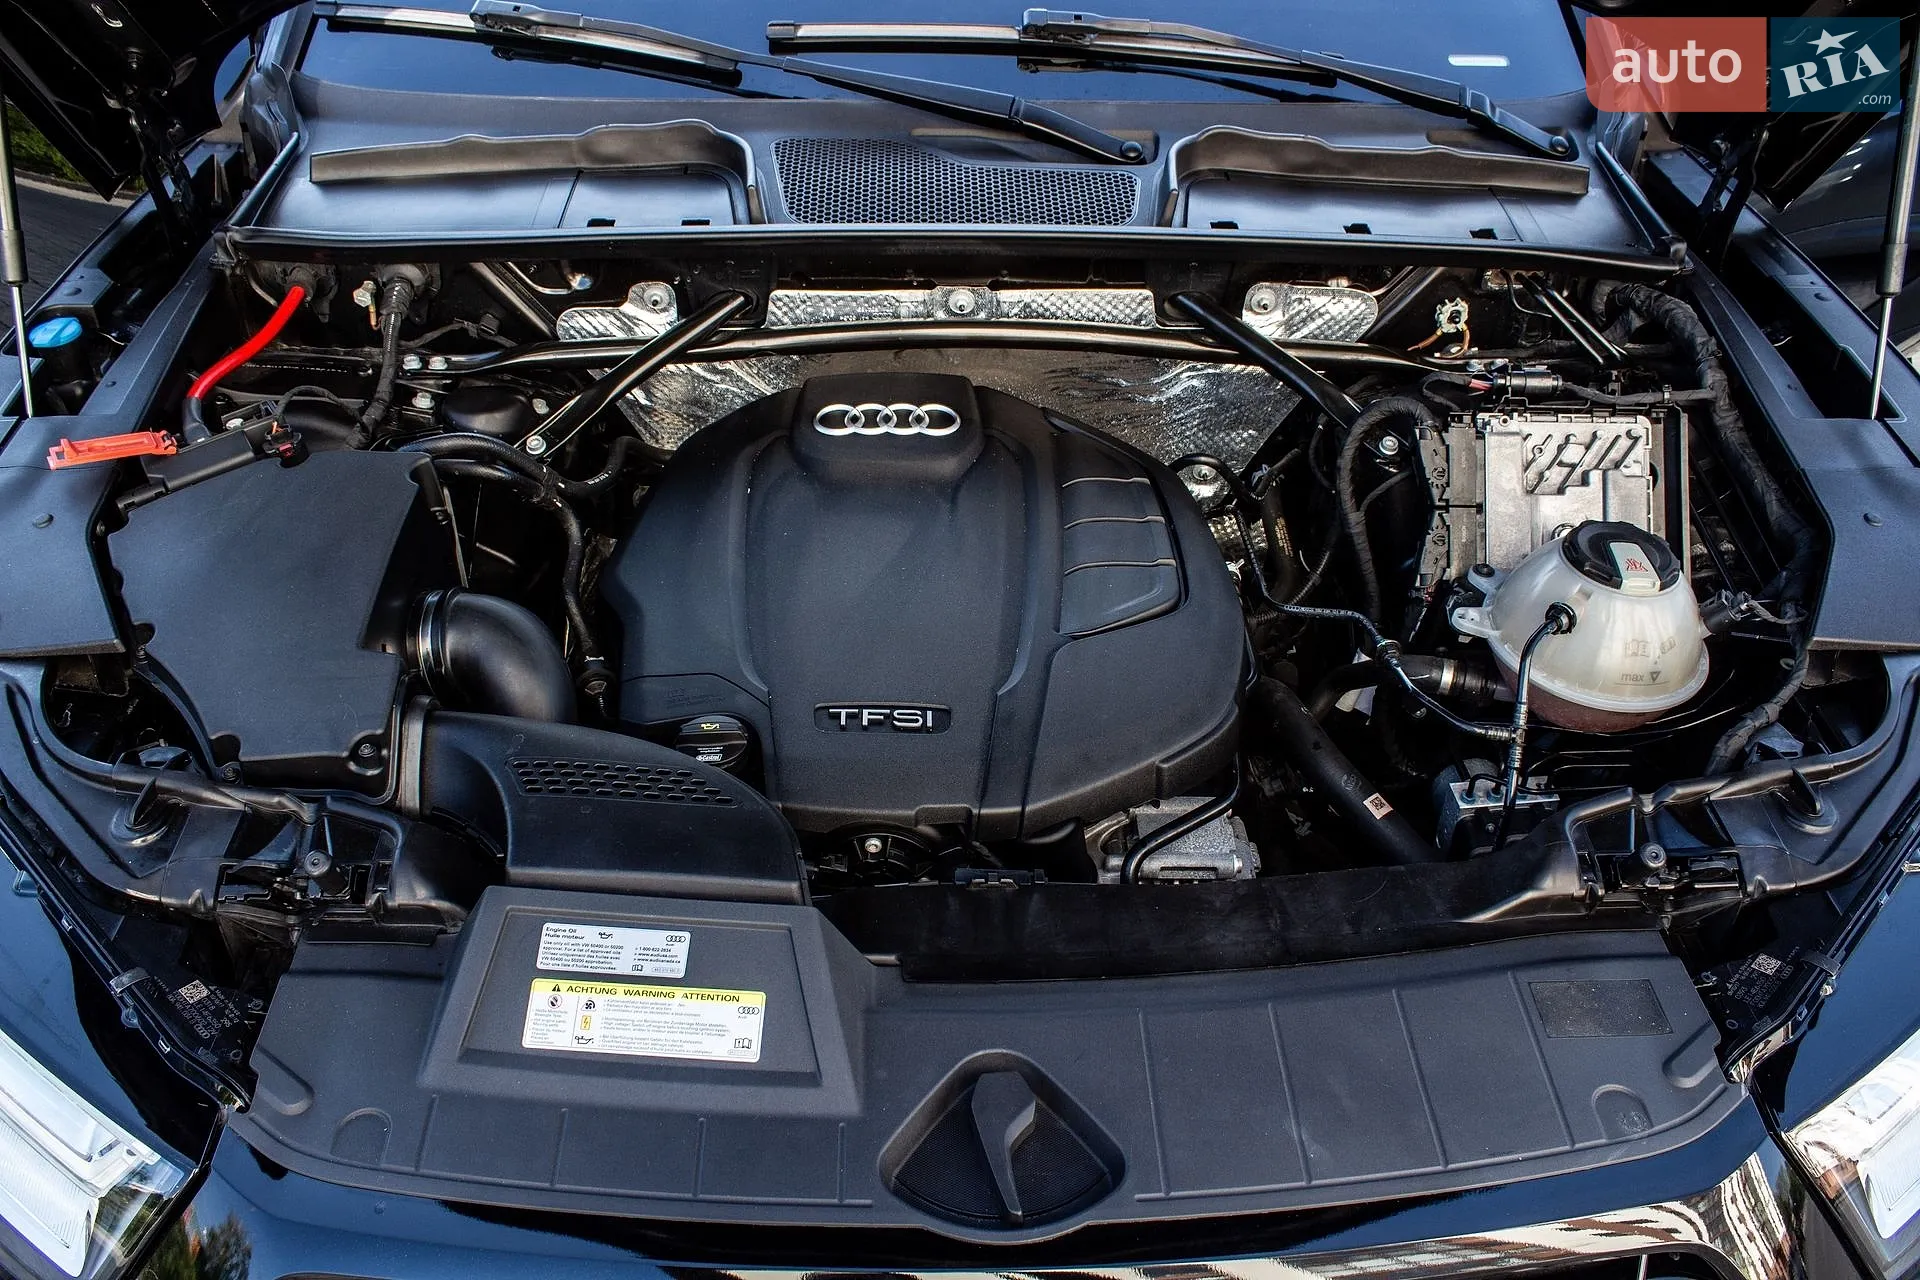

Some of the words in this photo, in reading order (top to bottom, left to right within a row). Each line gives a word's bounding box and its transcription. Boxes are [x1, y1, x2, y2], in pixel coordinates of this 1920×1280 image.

[1620, 671, 1645, 682] max
[829, 708, 933, 728] TFSI
[566, 985, 618, 995] ACHTUNG
[624, 988, 676, 999] WARNING
[682, 992, 740, 1002] ATTENTION
